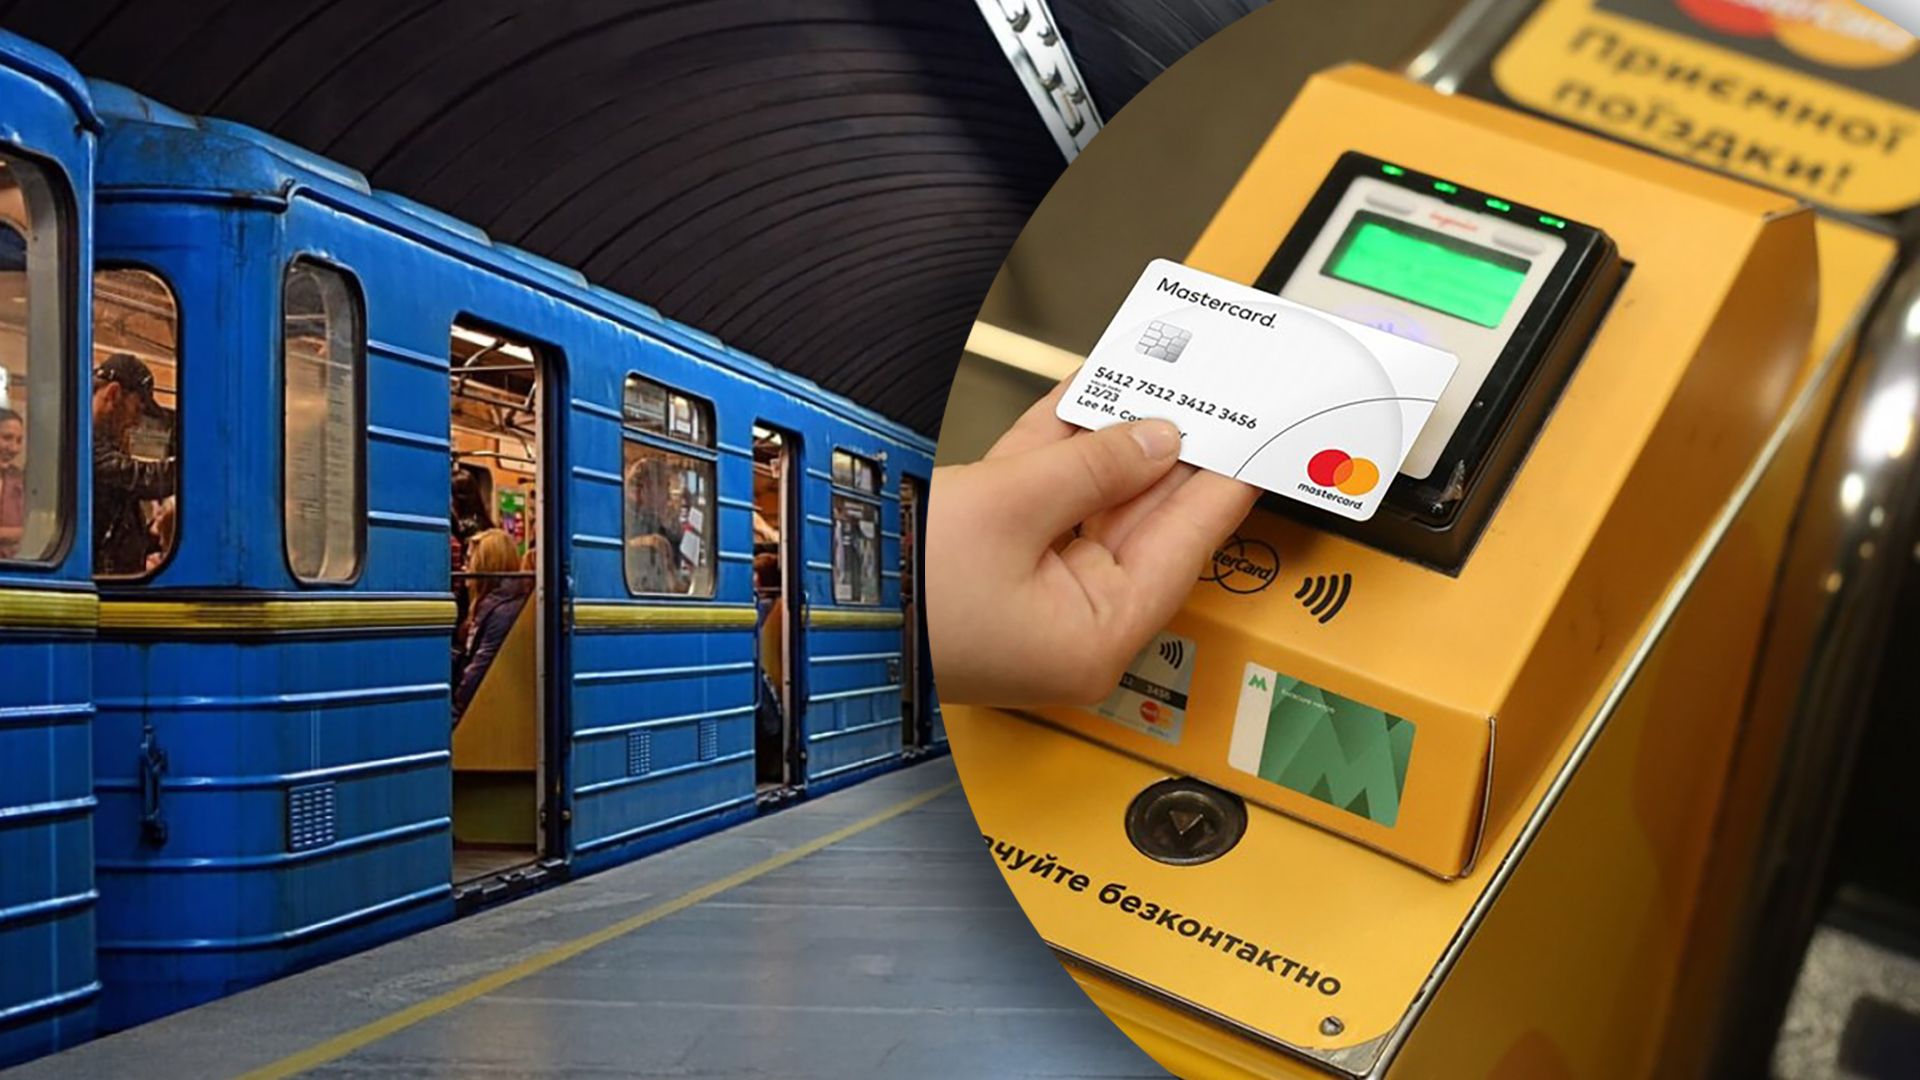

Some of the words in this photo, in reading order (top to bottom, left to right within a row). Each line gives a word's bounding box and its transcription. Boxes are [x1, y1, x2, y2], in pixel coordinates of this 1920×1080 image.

[1567, 25, 1908, 155] Приємної
[1554, 79, 1856, 195] поїздки!
[1076, 395, 1099, 410] Lee
[1084, 384, 1120, 402] 12/23
[1094, 366, 1134, 388] 5412
[1136, 380, 1175, 402] 7512
[1176, 393, 1216, 416] 3412
[1218, 407, 1258, 430] 3456
[1098, 883, 1342, 997] безконтактно
